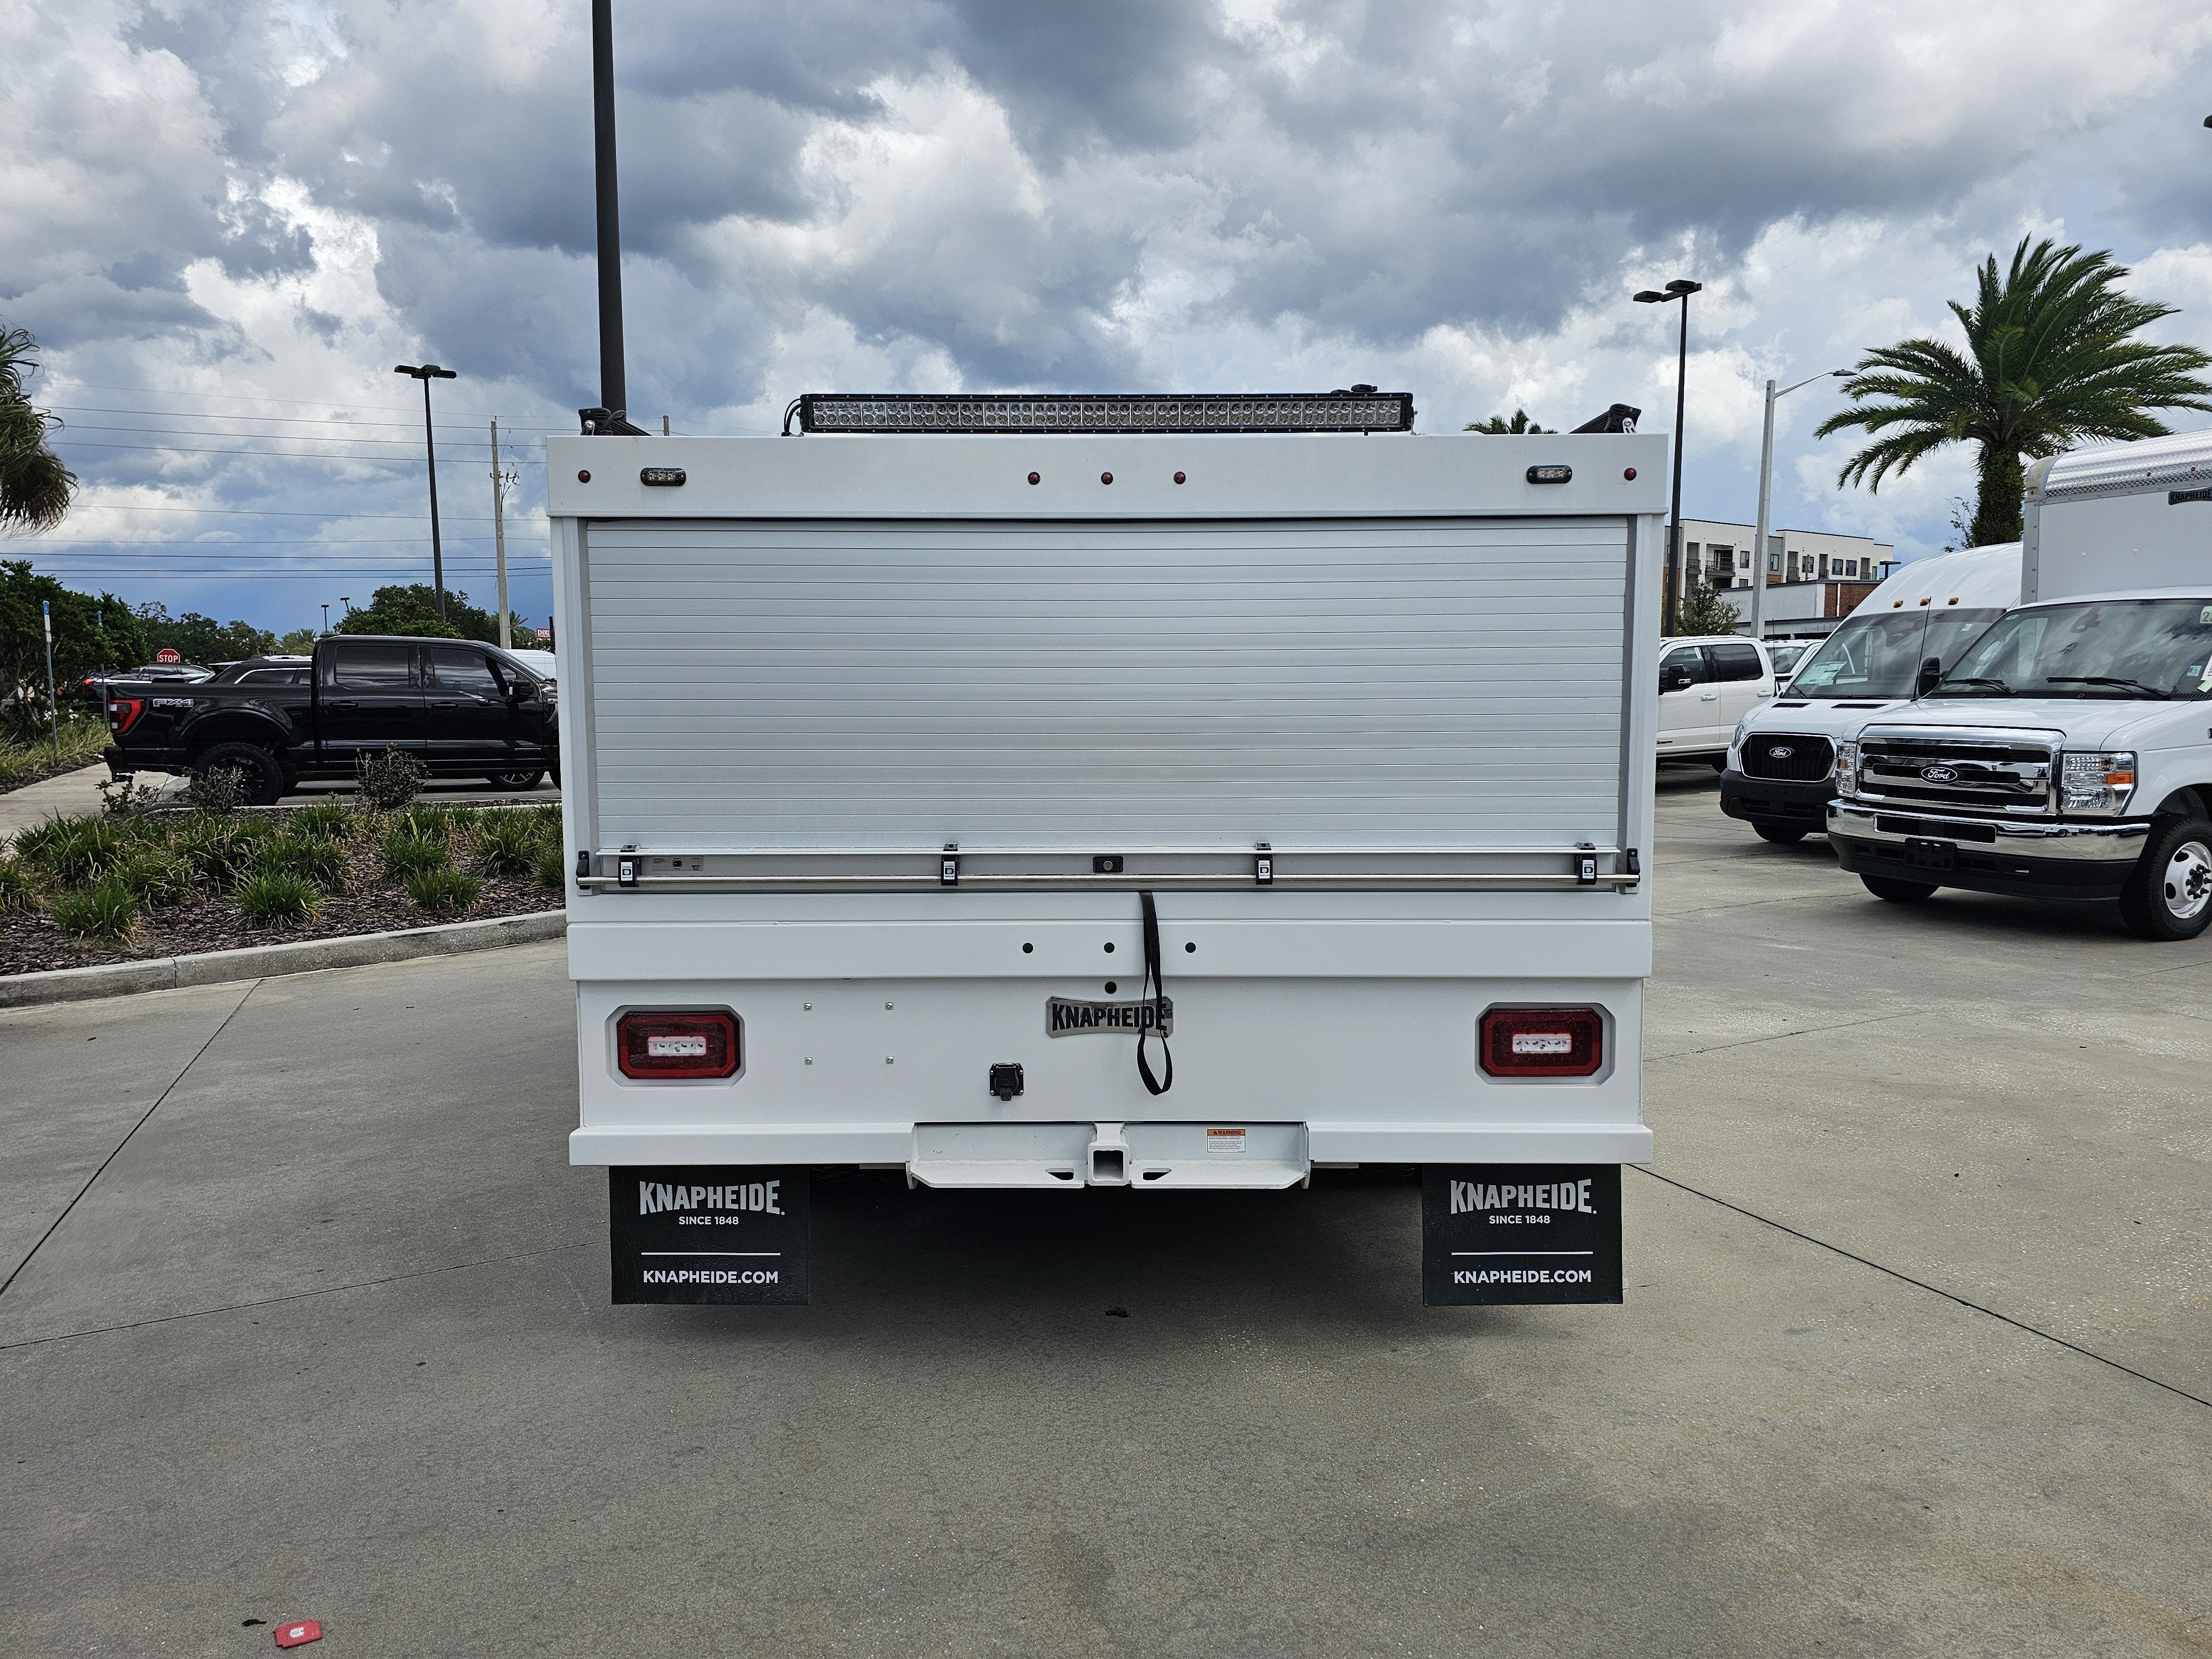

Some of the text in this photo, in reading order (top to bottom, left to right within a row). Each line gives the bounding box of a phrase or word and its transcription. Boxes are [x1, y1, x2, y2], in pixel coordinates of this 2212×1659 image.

[2170, 489, 2212, 503] KNAPHEIDE
[153, 698, 194, 707] FX4
[1927, 768, 1950, 779] Ford
[1052, 1003, 1167, 1031] KNAPHEIDE
[679, 1216, 739, 1225] SINCE 1848
[1489, 1215, 1550, 1224] SINCE 1848
[643, 1270, 779, 1284] KNAPHEIDE.COM
[1453, 1270, 1592, 1284] KNAPHEIDE.COM
